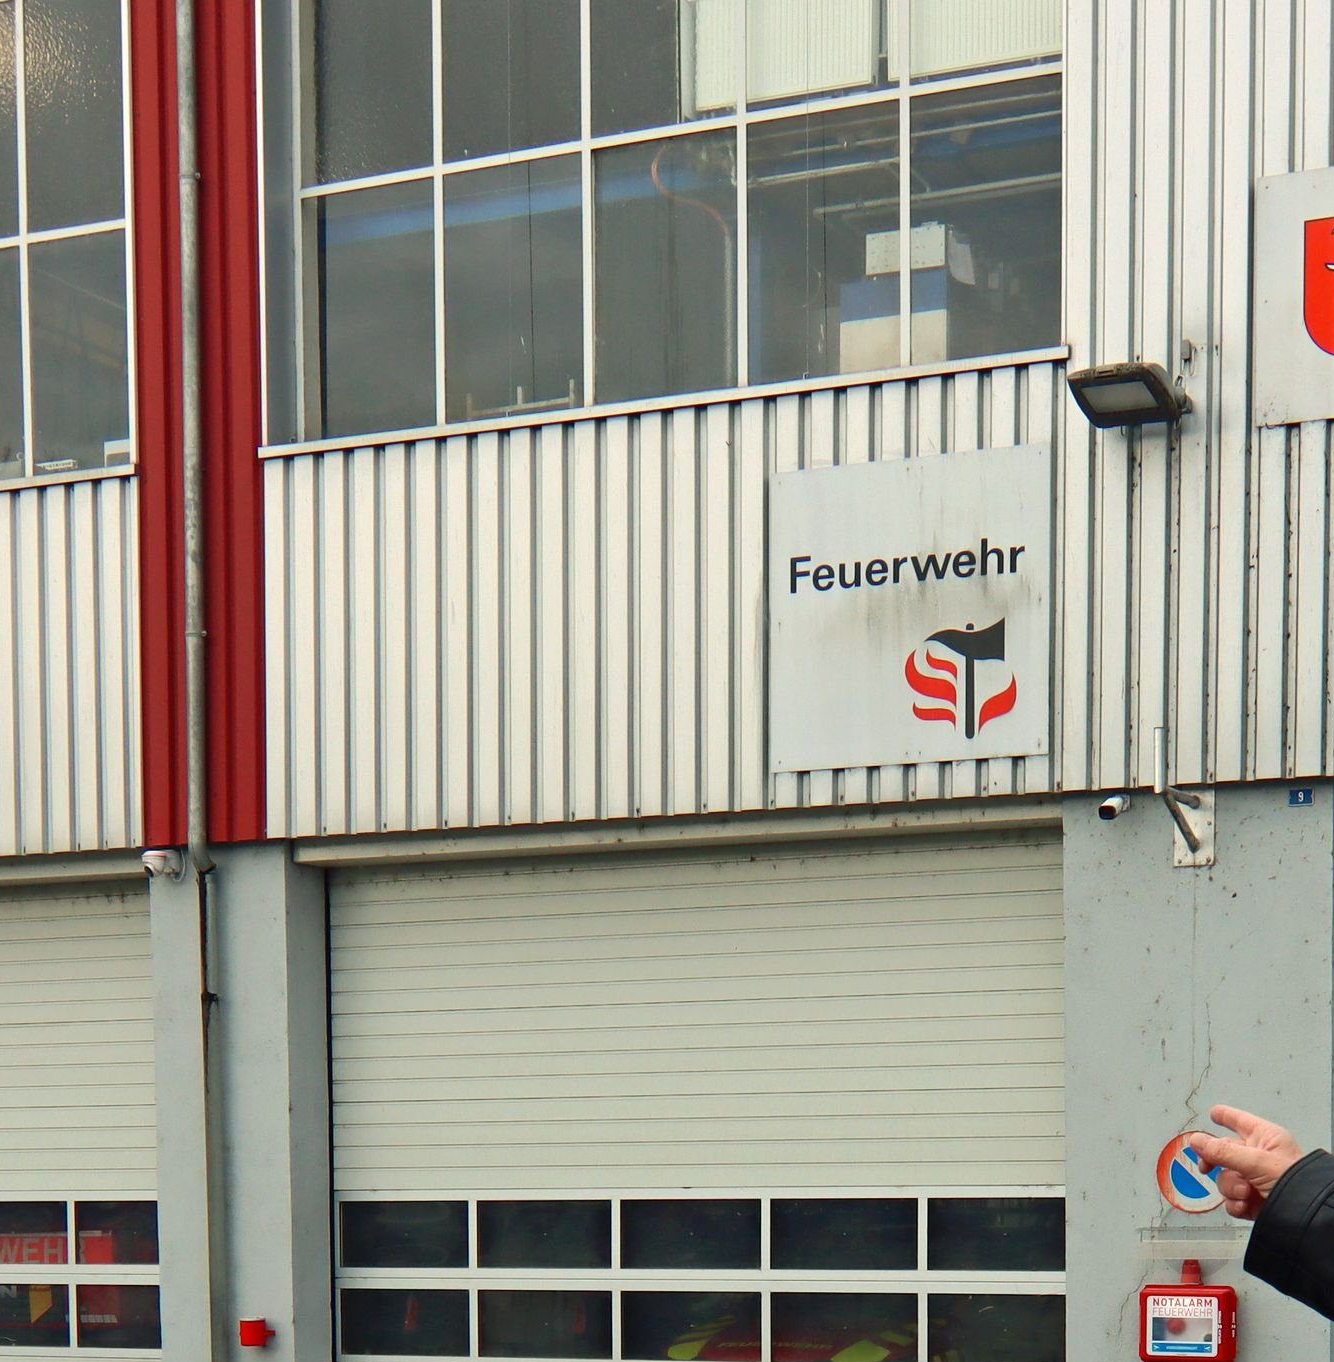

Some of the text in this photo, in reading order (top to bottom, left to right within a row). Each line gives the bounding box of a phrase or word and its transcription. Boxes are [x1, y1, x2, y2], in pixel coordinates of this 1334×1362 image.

[789, 538, 1026, 594] Feuerwehr
[1298, 791, 1304, 802] 9
[1152, 1298, 1213, 1308] NOTALARM
[1152, 1307, 1214, 1317] FEUERWEHR
